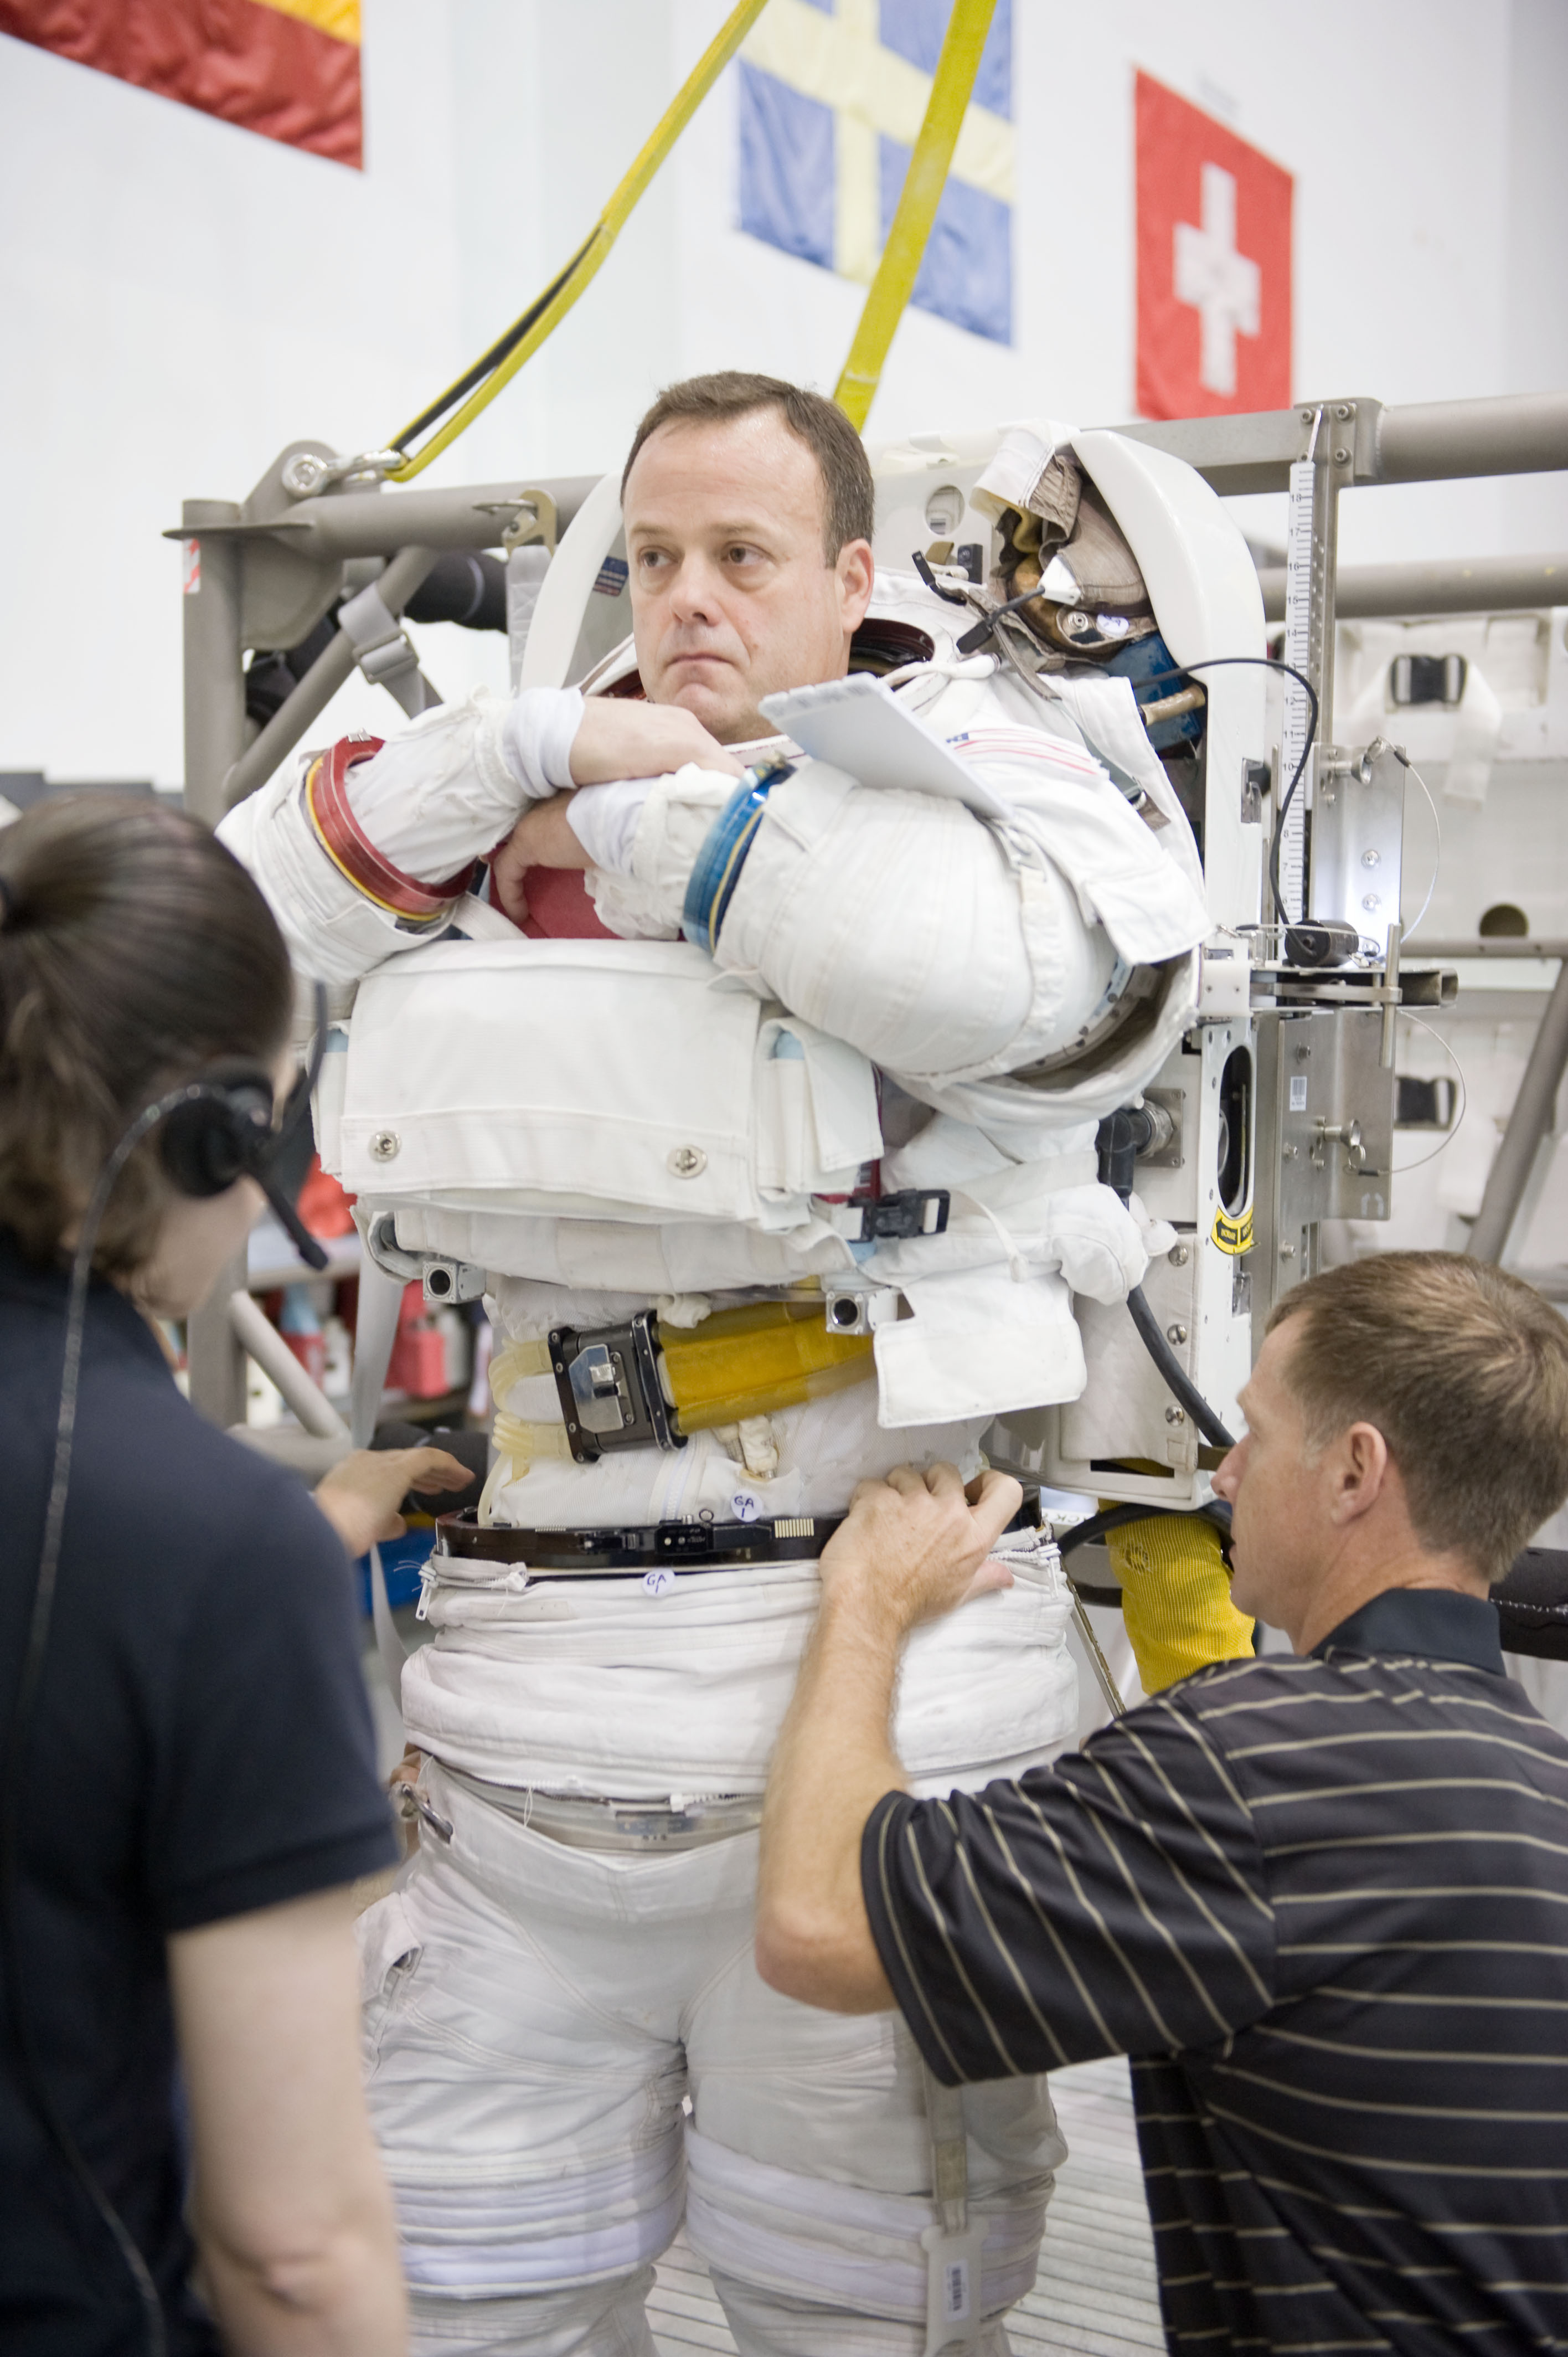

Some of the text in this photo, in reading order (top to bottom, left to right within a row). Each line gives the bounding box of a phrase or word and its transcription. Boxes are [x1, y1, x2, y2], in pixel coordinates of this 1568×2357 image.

[1291, 493, 1302, 503] 18
[1290, 527, 1300, 536] 17
[1288, 562, 1299, 571] 16
[1288, 596, 1298, 605] 15
[1285, 697, 1296, 706] 12
[1283, 830, 1289, 838] 8
[1283, 862, 1288, 871] 7
[734, 1495, 754, 1508] GA
